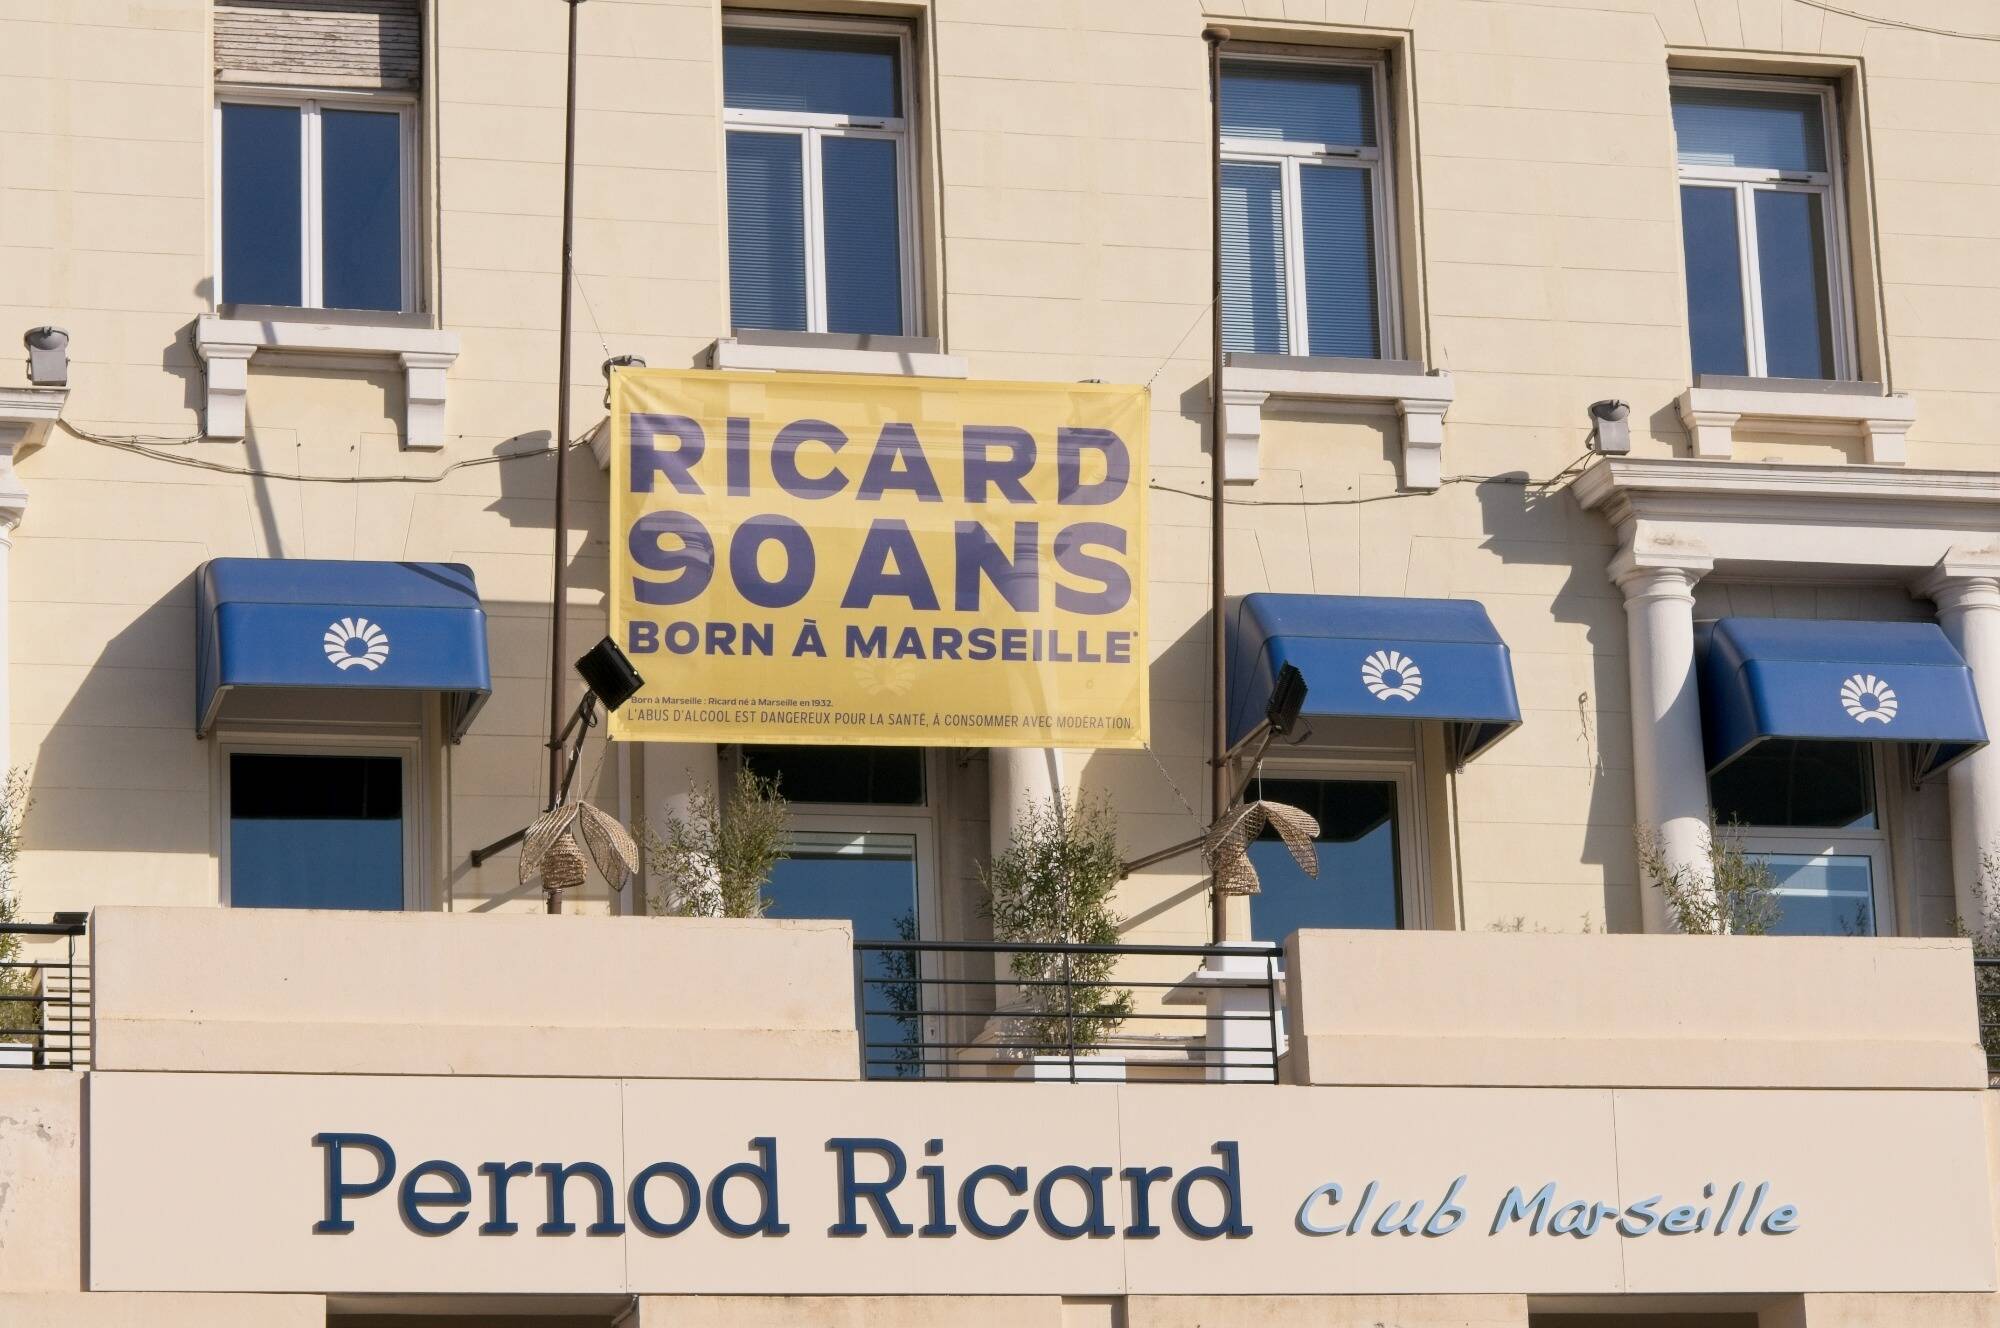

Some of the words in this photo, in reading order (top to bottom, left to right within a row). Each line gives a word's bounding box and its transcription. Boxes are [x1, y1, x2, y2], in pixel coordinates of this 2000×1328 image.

[630, 412, 1132, 505] RICARD
[628, 510, 816, 609] 90
[840, 518, 1133, 615] ANS
[628, 620, 774, 657] BORN
[792, 618, 828, 658] À
[627, 708, 669, 721] L'ABUS
[673, 709, 731, 723] D'ALCOOL
[735, 710, 756, 723] EST
[760, 711, 831, 725] DANGEREUX
[834, 712, 866, 725] POUR
[870, 712, 884, 726] LA
[932, 712, 940, 727] À
[944, 714, 1018, 728] CONSOMMER
[1022, 715, 1053, 728] AVEC
[662, 696, 702, 705] Marseille
[708, 697, 736, 706] Ricard
[738, 697, 749, 706] né
[758, 697, 798, 707] Marseille
[799, 699, 810, 707] en
[312, 1132, 790, 1237] Pernod
[826, 1136, 1254, 1240] Ricard
[1295, 1174, 1468, 1238] Club
[1488, 1180, 1800, 1239] Marseille
